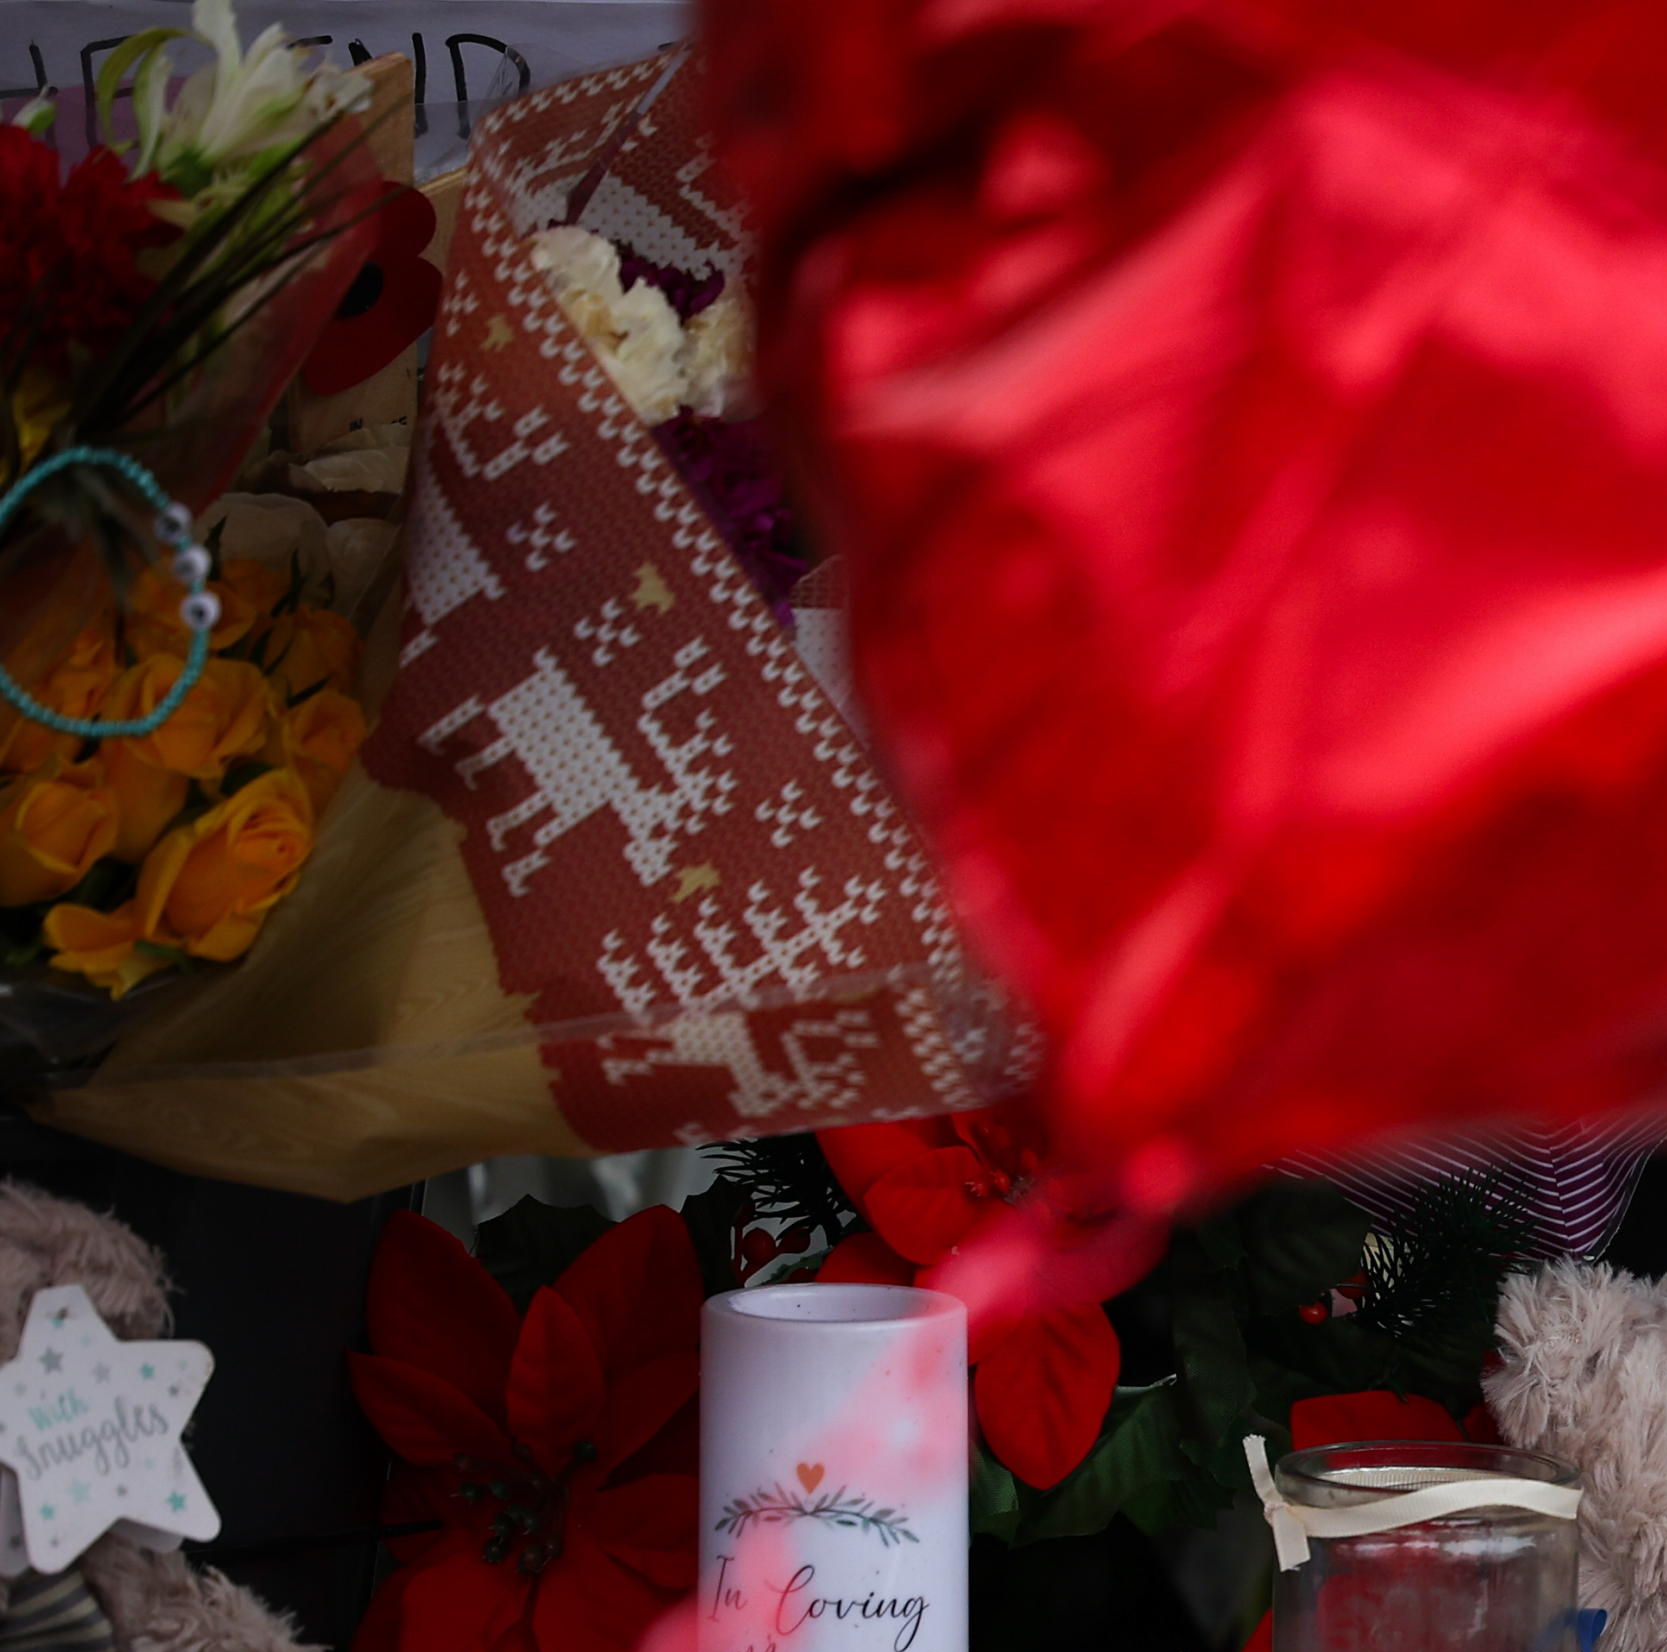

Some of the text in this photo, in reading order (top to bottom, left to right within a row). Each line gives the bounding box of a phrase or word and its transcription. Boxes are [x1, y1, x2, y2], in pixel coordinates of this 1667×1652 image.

[17, 1396, 169, 1481] Snuggles
[706, 1555, 930, 1652] In Loving
